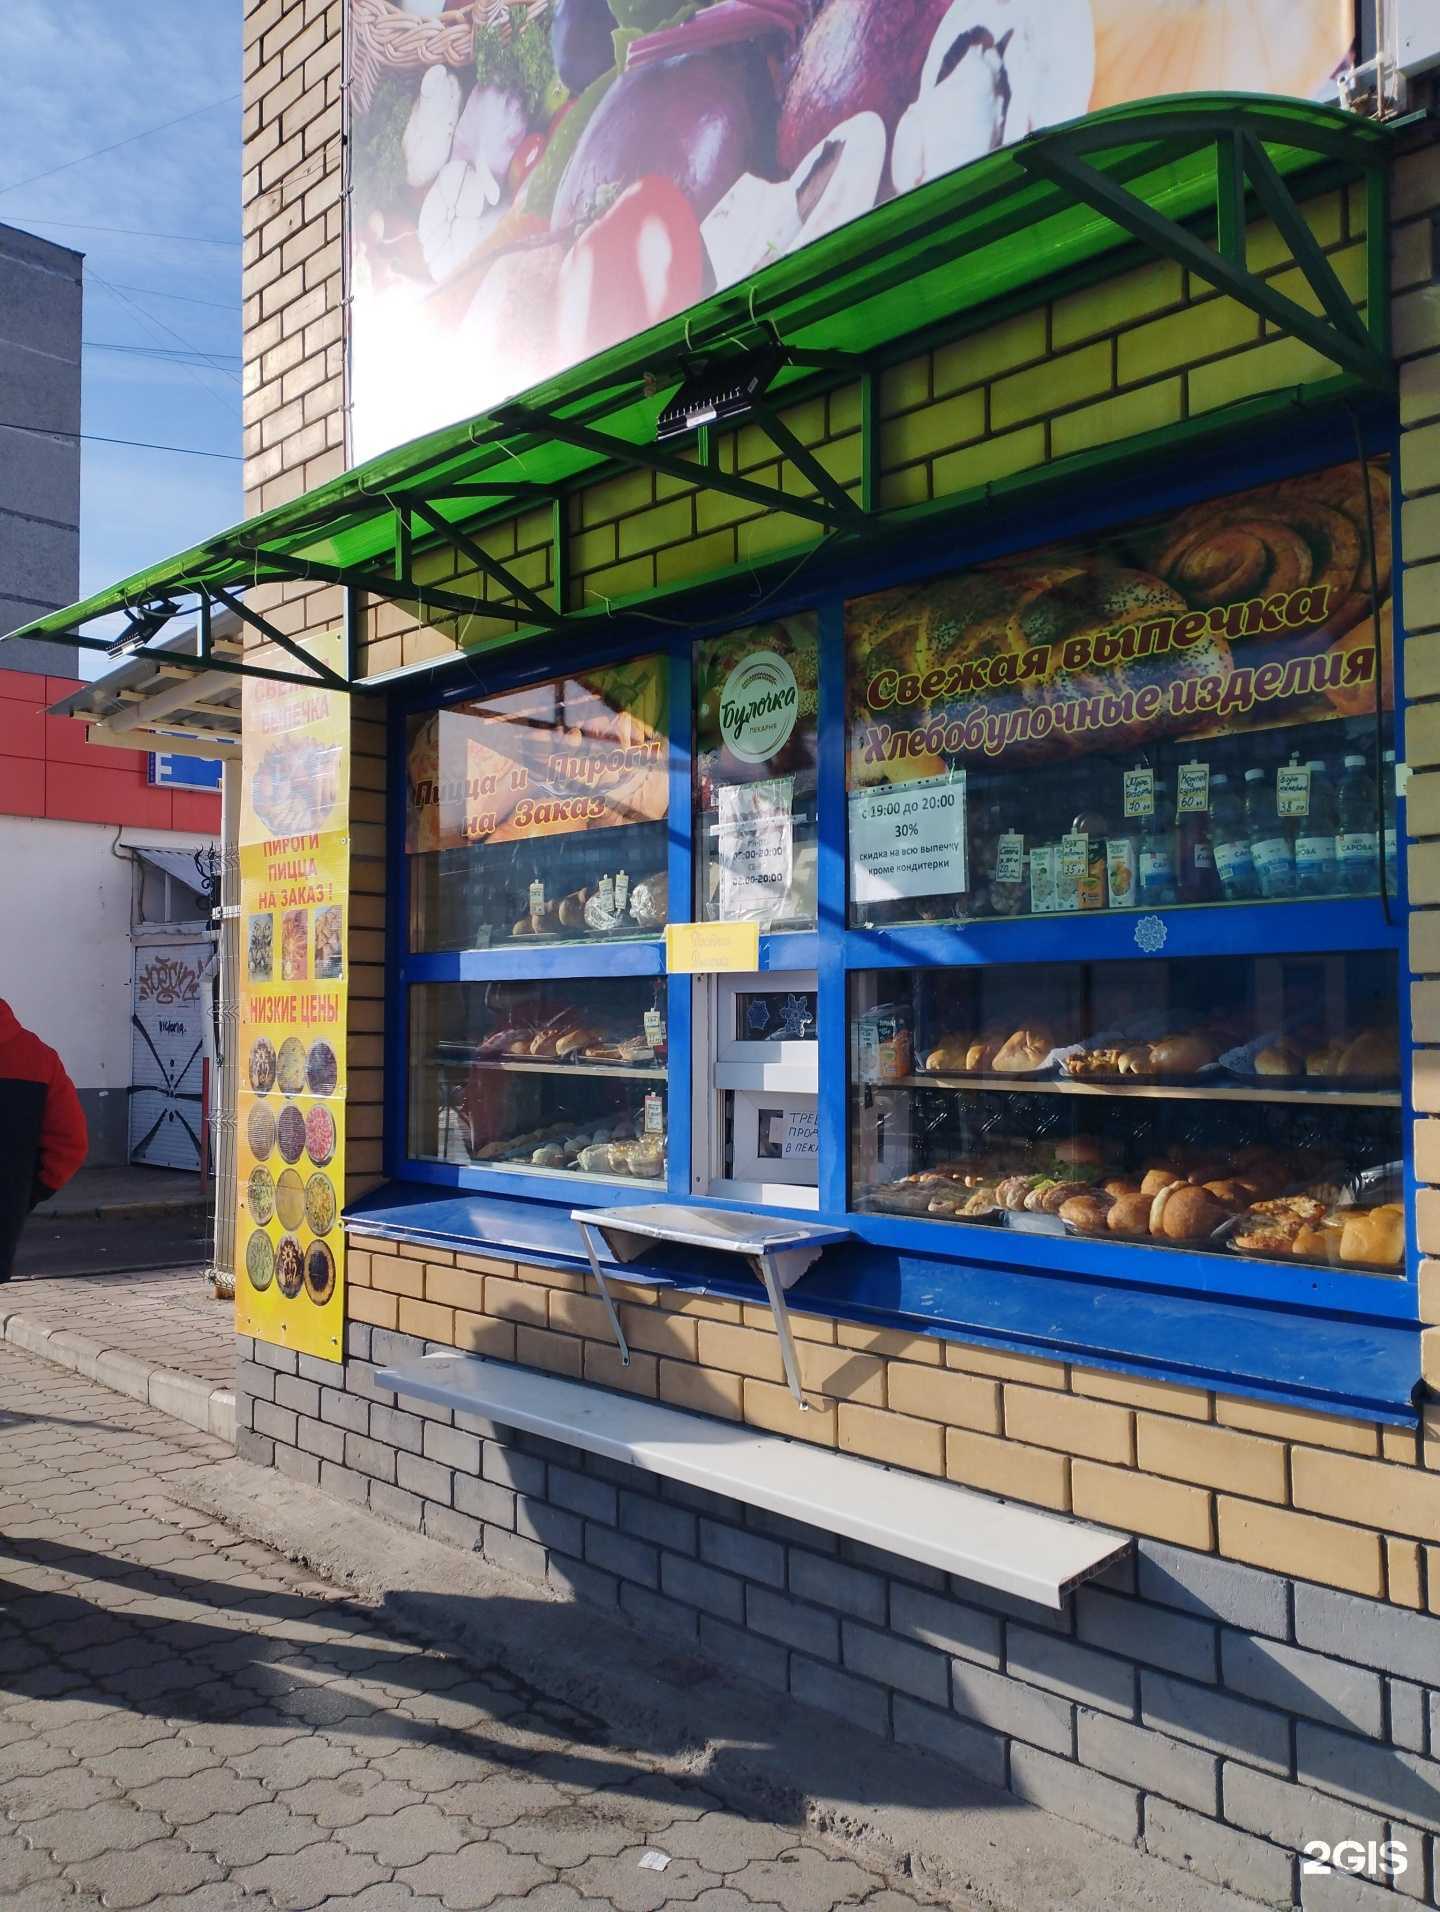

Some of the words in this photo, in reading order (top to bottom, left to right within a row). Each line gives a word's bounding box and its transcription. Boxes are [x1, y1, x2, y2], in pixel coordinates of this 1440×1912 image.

[866, 644, 1053, 710] Свежая
[1061, 584, 1330, 671] выпечка
[722, 687, 796, 740] Булочка
[862, 683, 1162, 766] Хлебобулочные
[1168, 645, 1377, 715] изделия
[511, 767, 529, 791] и
[546, 742, 662, 788] Пироги
[461, 812, 497, 838] на
[515, 796, 606, 829] Заказ
[870, 802, 900, 818] 19:00
[902, 802, 918, 816] до
[922, 794, 955, 810] 20:00
[895, 823, 919, 838] 30%
[263, 834, 320, 858] ПИРОГИ
[859, 850, 888, 861] скидка
[920, 842, 959, 854] выпечку
[268, 858, 318, 882] ПИЦЦА
[868, 865, 895, 877] кроме
[258, 890, 277, 909] НА
[250, 995, 297, 1025] НИЗКИЕ
